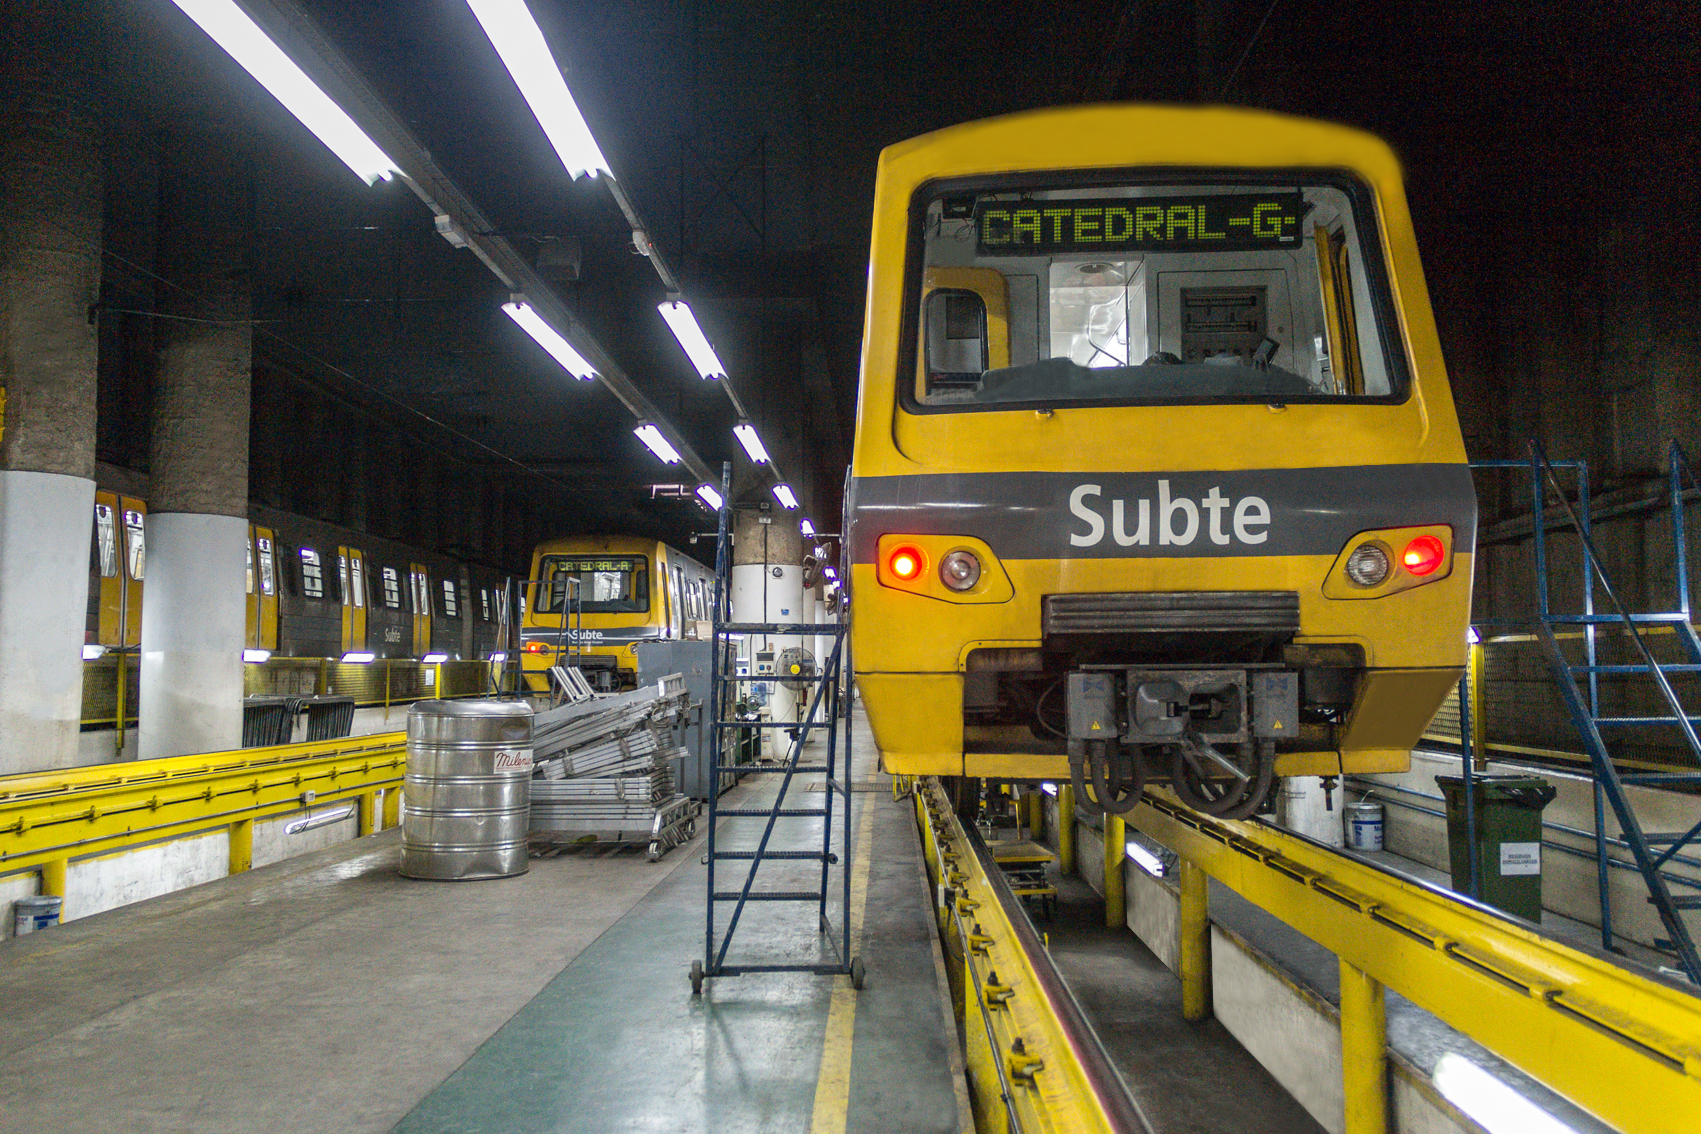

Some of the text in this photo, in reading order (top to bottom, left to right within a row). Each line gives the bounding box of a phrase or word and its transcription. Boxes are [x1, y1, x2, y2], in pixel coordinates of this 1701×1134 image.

[1069, 479, 1272, 547] Subte
[385, 627, 400, 643] Subte
[572, 629, 603, 640] Subte
